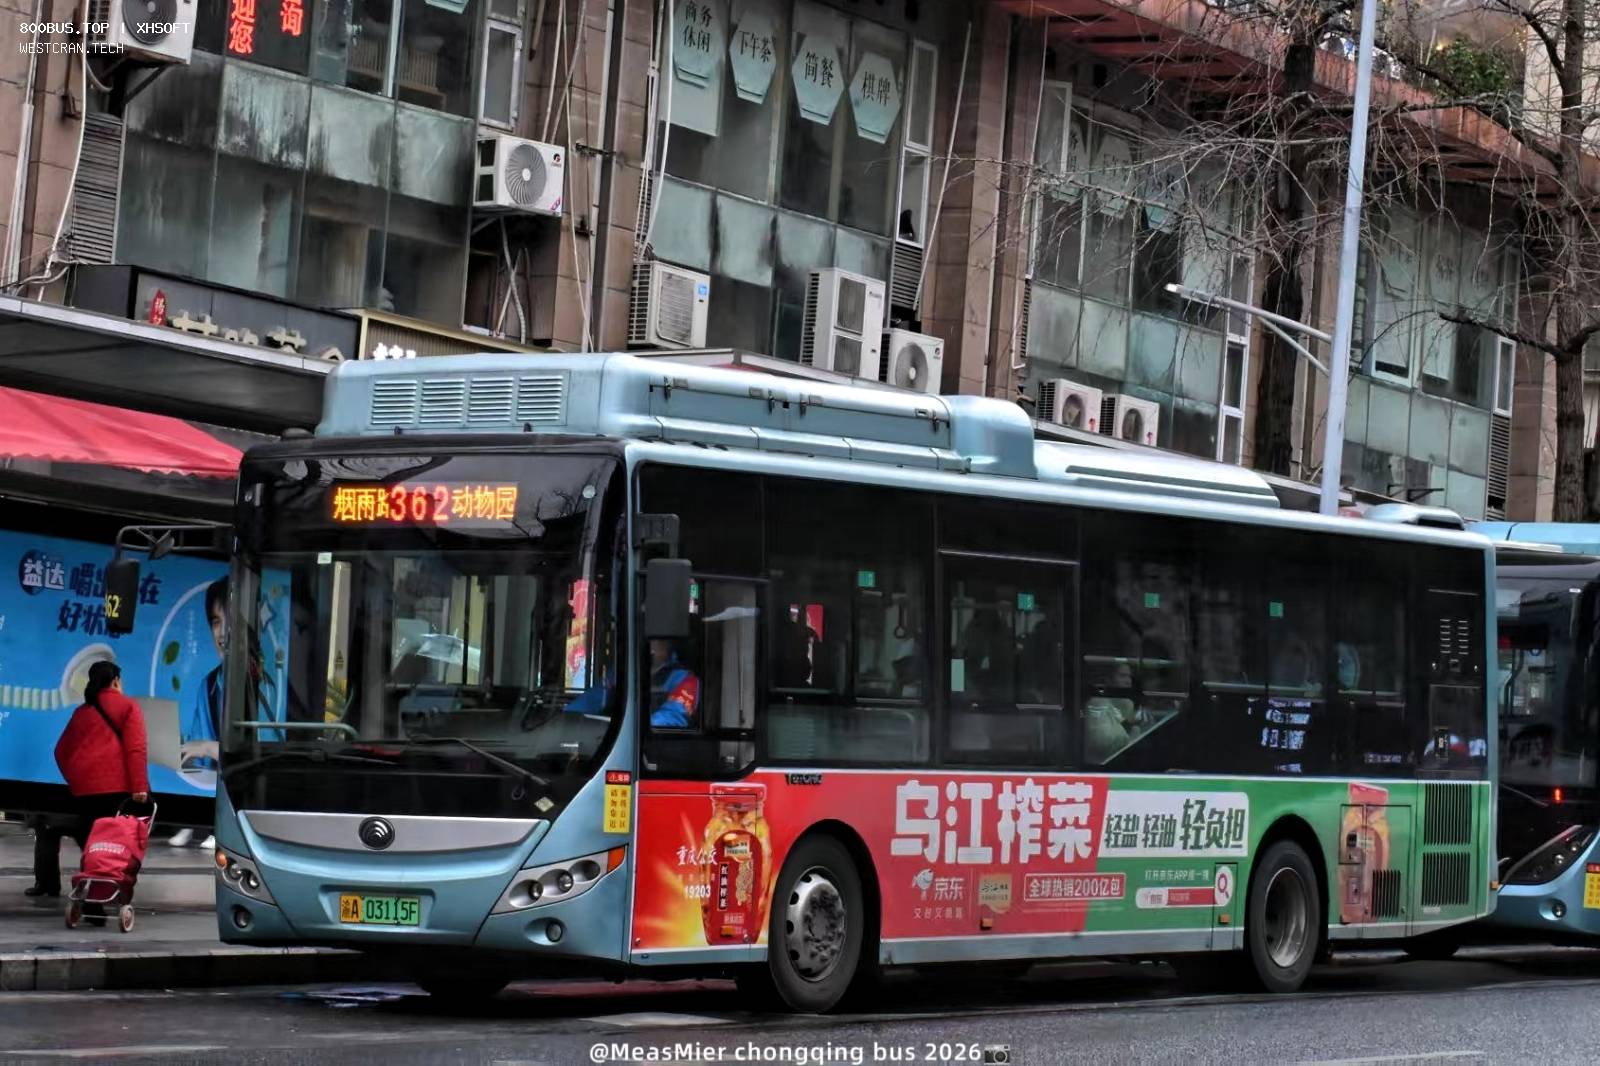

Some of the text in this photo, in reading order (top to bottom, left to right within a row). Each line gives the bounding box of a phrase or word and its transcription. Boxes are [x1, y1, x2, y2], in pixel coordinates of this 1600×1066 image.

[280, 0, 303, 35] 询
[685, 0, 713, 28] 商务
[682, 25, 711, 53] 休闲
[738, 30, 772, 63] 下午茶
[804, 51, 834, 89] 简餐
[862, 71, 891, 106] 棋牌
[390, 485, 449, 521] 362
[451, 485, 518, 520] 动物园
[23, 559, 65, 590] 益达
[57, 599, 121, 639] 好状
[104, 594, 121, 618] 62
[890, 777, 1093, 865] 乌江榨菜
[1180, 798, 1246, 851] 轻负担
[684, 884, 712, 899] 19203
[934, 876, 965, 901] 京东
[1028, 877, 1121, 898] 全球热销200亿包
